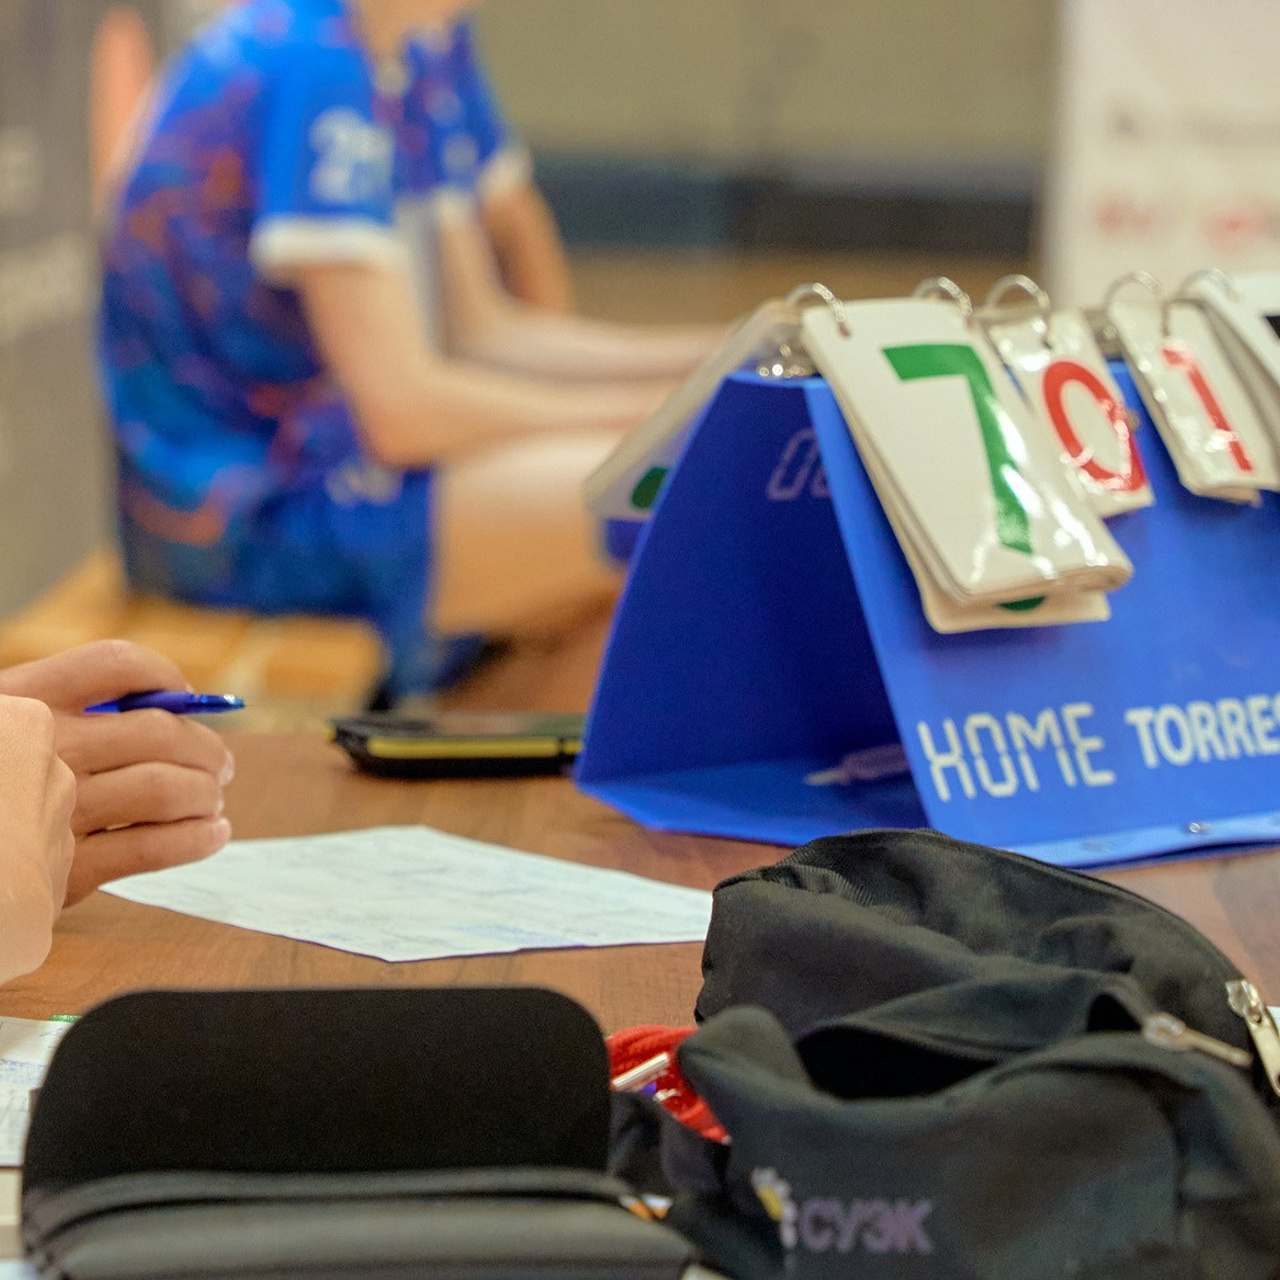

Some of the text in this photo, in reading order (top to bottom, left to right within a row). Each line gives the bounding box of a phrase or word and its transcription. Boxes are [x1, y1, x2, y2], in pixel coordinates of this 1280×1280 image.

[883, 344, 1033, 555] 7
[1043, 360, 1146, 492] 0
[1161, 344, 1253, 472] 1
[918, 702, 1115, 802] HOME
